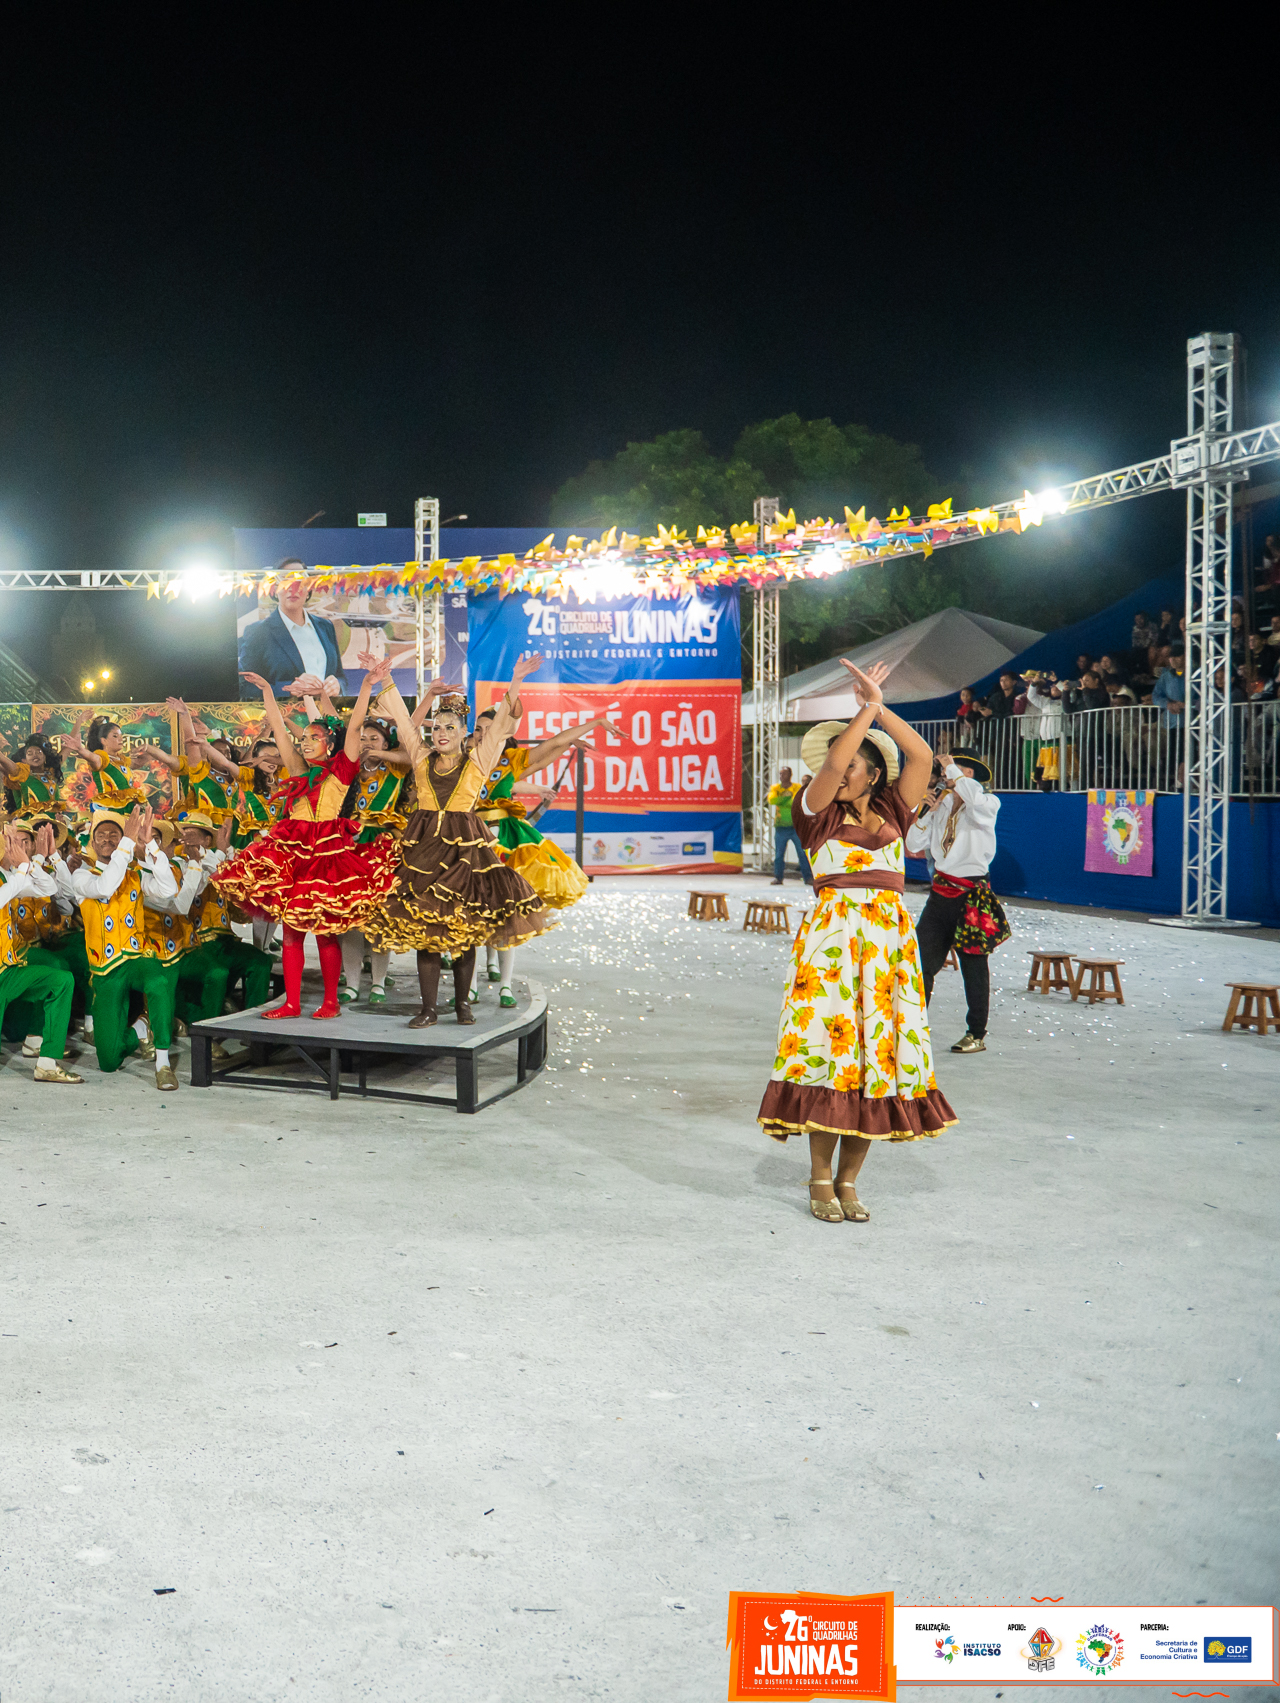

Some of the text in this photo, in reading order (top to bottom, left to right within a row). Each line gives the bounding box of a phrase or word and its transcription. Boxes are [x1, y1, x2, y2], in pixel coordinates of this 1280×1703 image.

[559, 611, 613, 623] CIRCUITO DE
[559, 622, 614, 635] QUADRILHAS
[608, 609, 718, 645] JUNINAS
[545, 649, 599, 660] DISTRITO
[603, 648, 652, 659] FEDERAL
[656, 649, 664, 659] E
[669, 648, 719, 659] ENTORNO
[605, 701, 623, 747] É
[631, 710, 652, 746] O
[660, 701, 717, 748] SÃO
[605, 755, 650, 793] DA
[658, 754, 725, 793] LIGA
